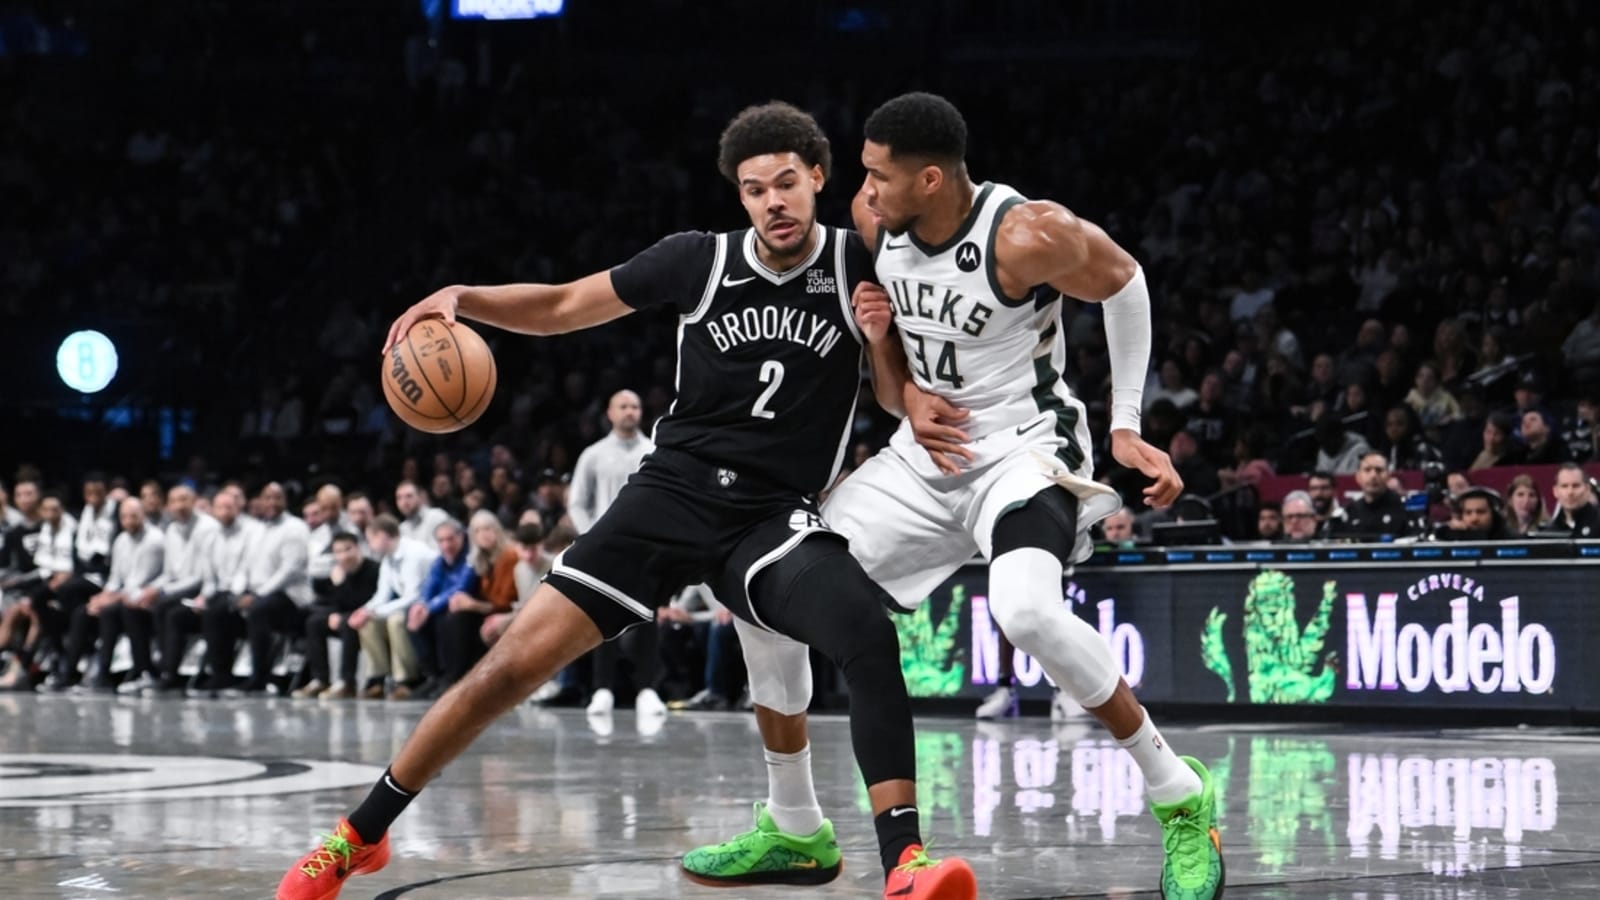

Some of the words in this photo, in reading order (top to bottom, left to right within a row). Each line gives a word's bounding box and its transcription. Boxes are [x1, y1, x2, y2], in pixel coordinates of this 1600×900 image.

[806, 269, 824, 277] GET
[806, 277, 835, 285] YOUR
[806, 285, 837, 293] GUIDE
[706, 305, 842, 358] BROOKLYN
[890, 280, 994, 337] UCKS
[905, 330, 965, 389] 34
[751, 360, 785, 419] 2
[1407, 573, 1485, 602] CERVEZA
[1346, 593, 1556, 694] Modelo
